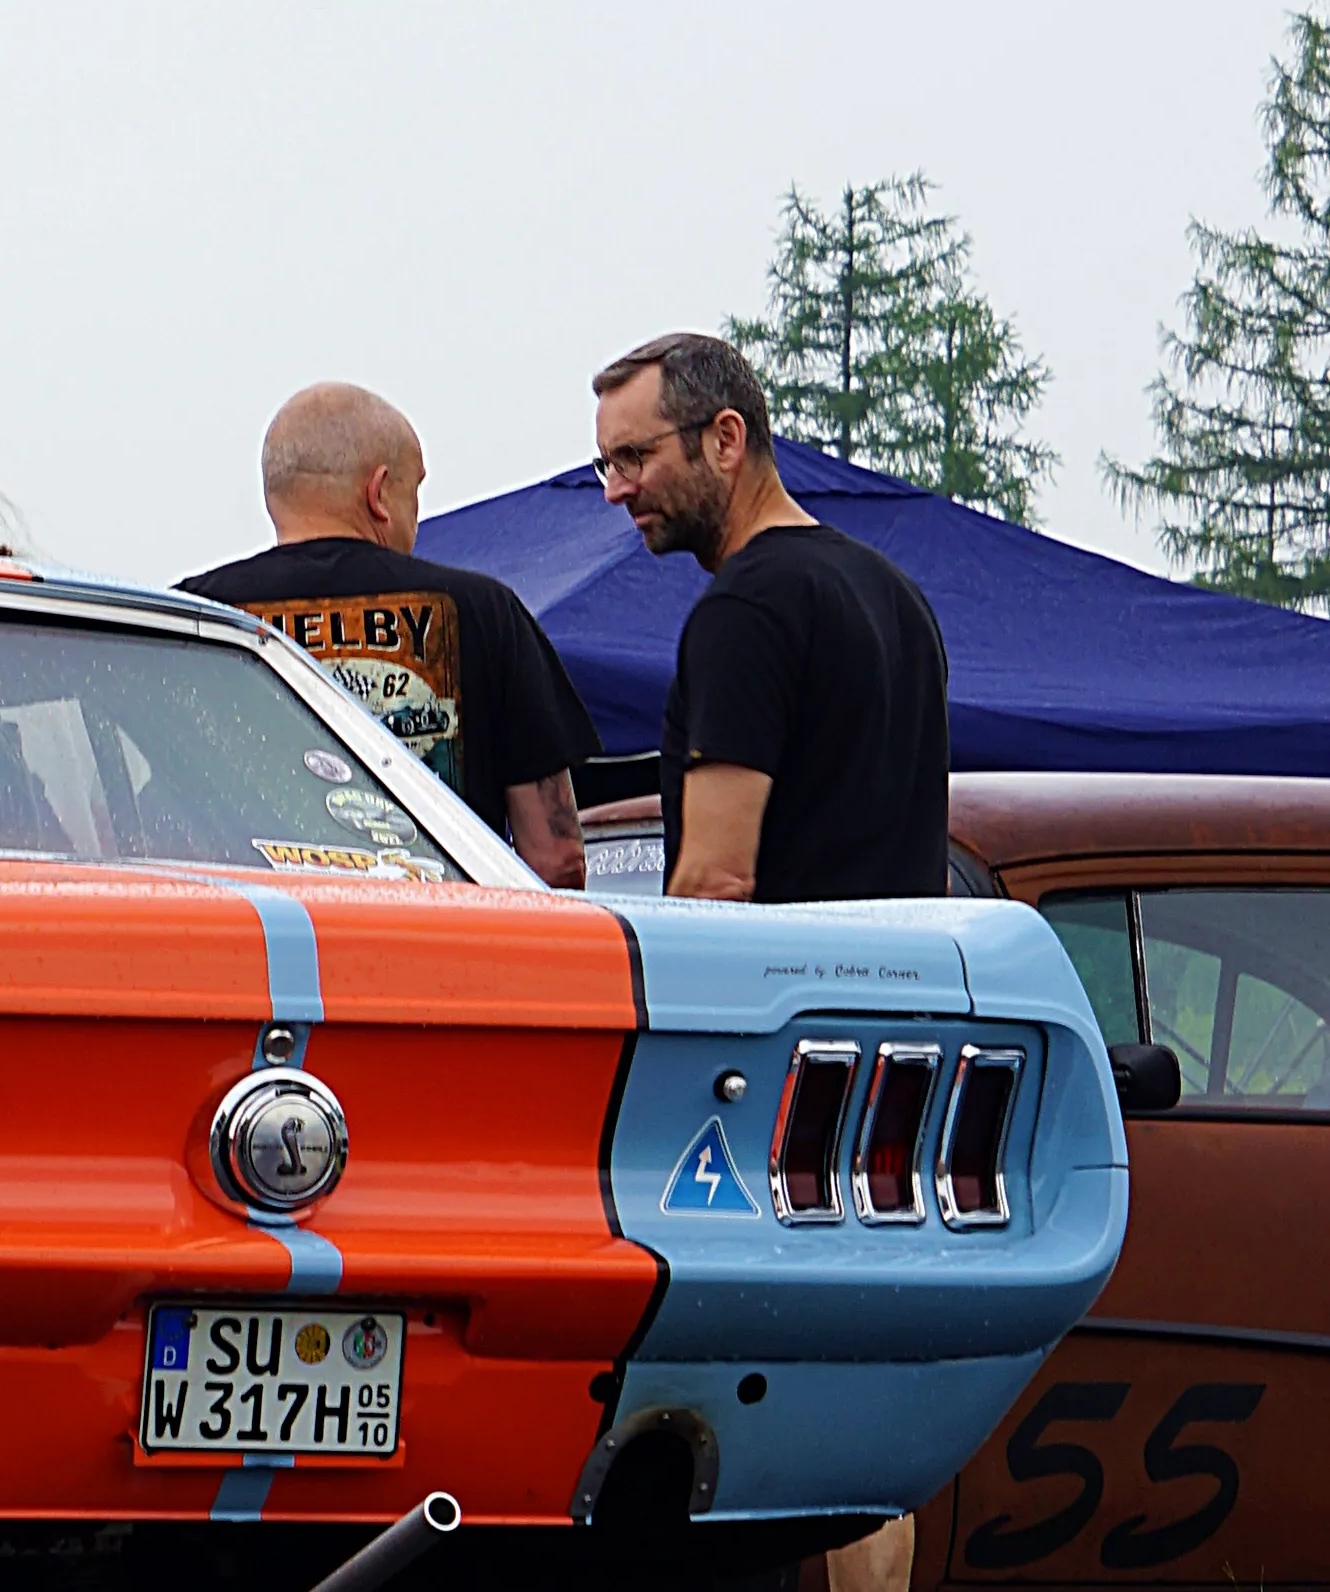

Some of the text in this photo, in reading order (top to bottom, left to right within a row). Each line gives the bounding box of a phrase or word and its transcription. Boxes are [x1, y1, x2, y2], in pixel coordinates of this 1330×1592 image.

[382, 672, 411, 699] 62
[262, 844, 378, 872] WOSP
[835, 963, 870, 979] Cobra
[163, 1345, 177, 1367] D
[206, 1317, 283, 1376] SU
[357, 1383, 390, 1408] 05
[154, 1379, 351, 1443] W 317H
[357, 1422, 389, 1447] 10
[964, 1381, 1267, 1570] 55
